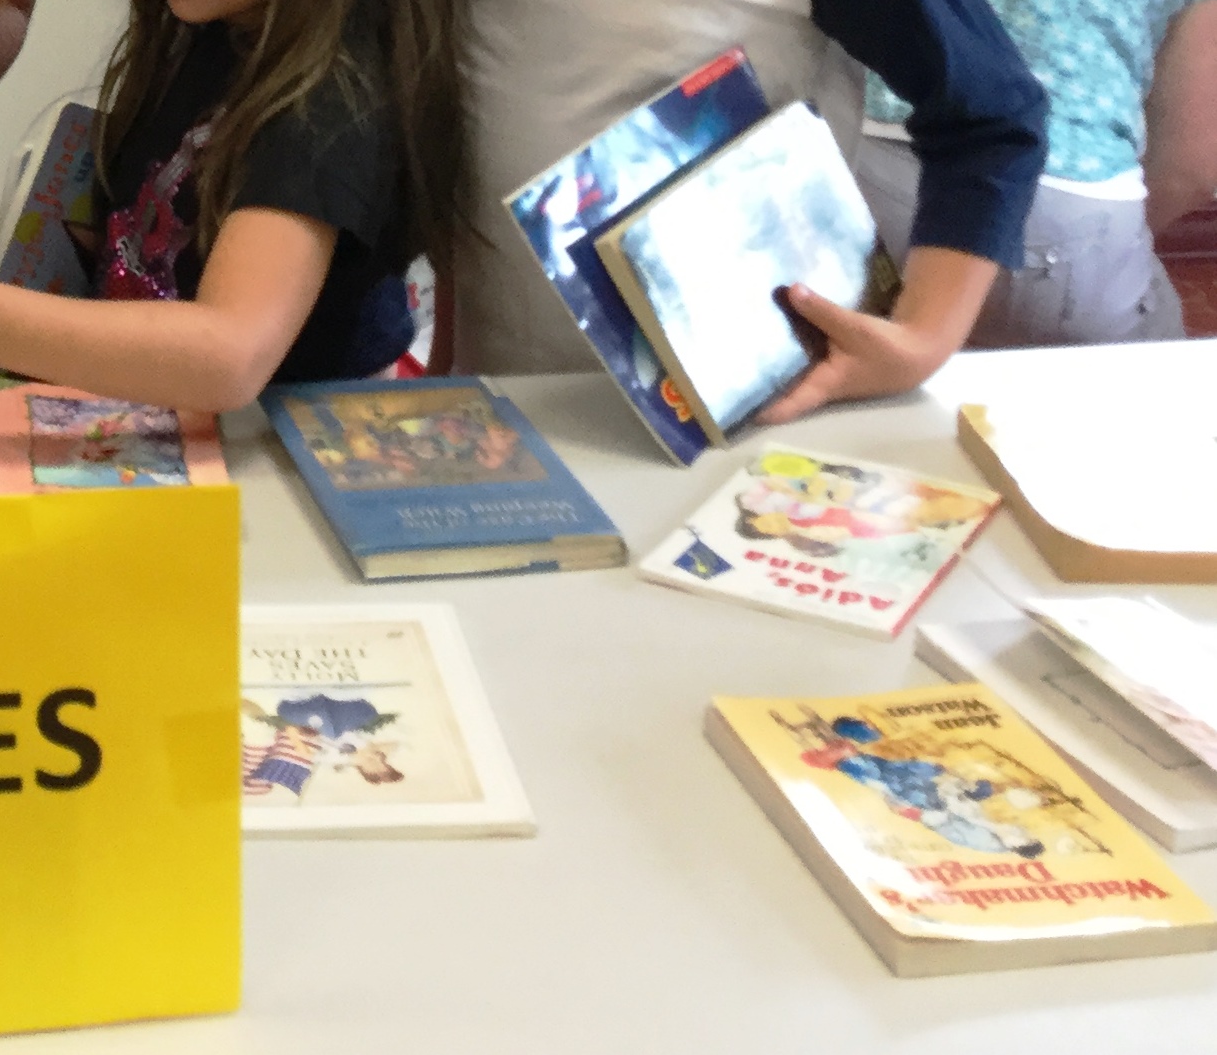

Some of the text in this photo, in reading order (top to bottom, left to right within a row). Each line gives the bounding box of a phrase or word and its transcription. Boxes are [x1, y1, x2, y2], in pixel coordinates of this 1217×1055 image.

[743, 550, 849, 583] Anna
[886, 699, 993, 719] Watson
[934, 712, 1002, 730] Jean
[880, 878, 1173, 912] Watchmak's
